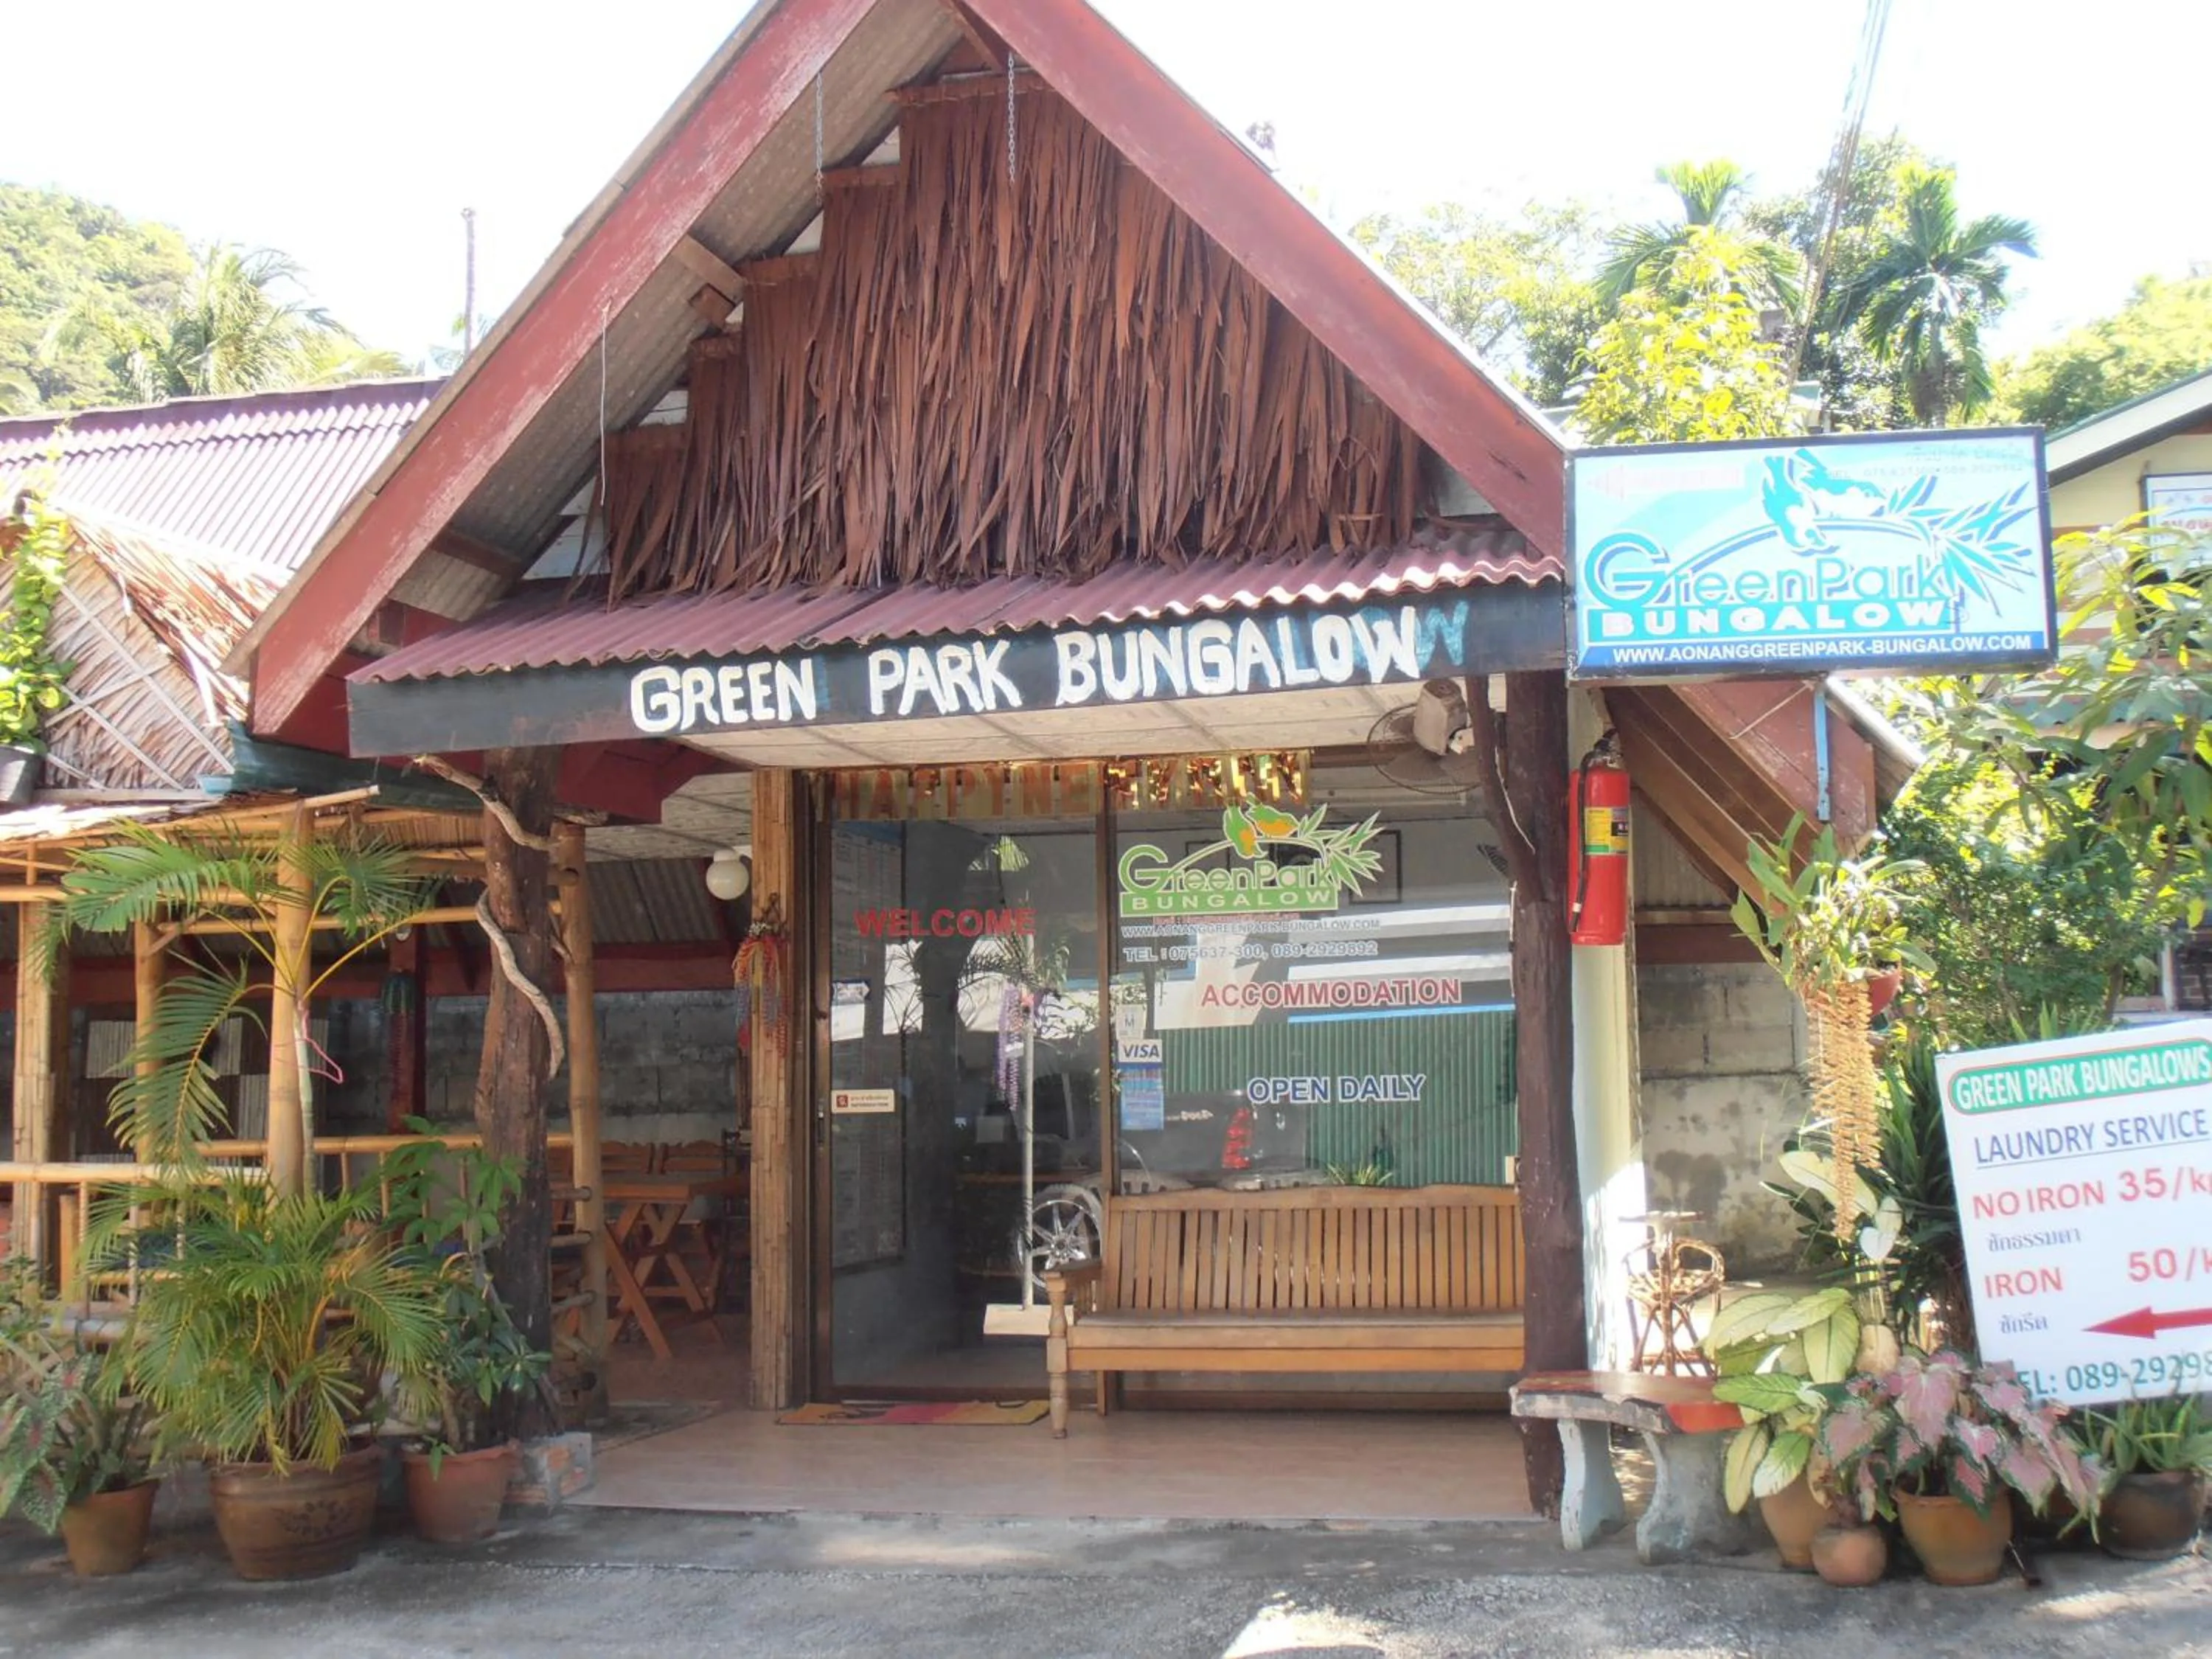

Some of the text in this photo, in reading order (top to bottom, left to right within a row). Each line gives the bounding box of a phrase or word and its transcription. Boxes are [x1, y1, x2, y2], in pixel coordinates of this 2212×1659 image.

[1601, 601, 1946, 636] BUNGALOW
[1613, 636, 2031, 662] WWW.AONANGGREENPARK-BUNGALOW.COM
[630, 661, 815, 732] GREEN
[869, 639, 1022, 714] PARK
[1054, 606, 1418, 704] BUNGALOW
[1131, 891, 1330, 910] BUNGALOW
[853, 908, 1037, 937] WELCOME
[1201, 978, 1461, 1007] ACCOMMODATION
[1123, 1044, 1160, 1059] VISA
[1248, 1074, 1425, 1104] OPEN DAILY
[1955, 1046, 2211, 1110] GREEN PARK BUNGALOWS
[1975, 1110, 2208, 1164] LAUNDRY SERVICE
[1973, 1166, 2212, 1219] NO IRON 35/k
[1984, 1267, 2063, 1299] IRON
[2017, 1369, 2058, 1397] EL:
